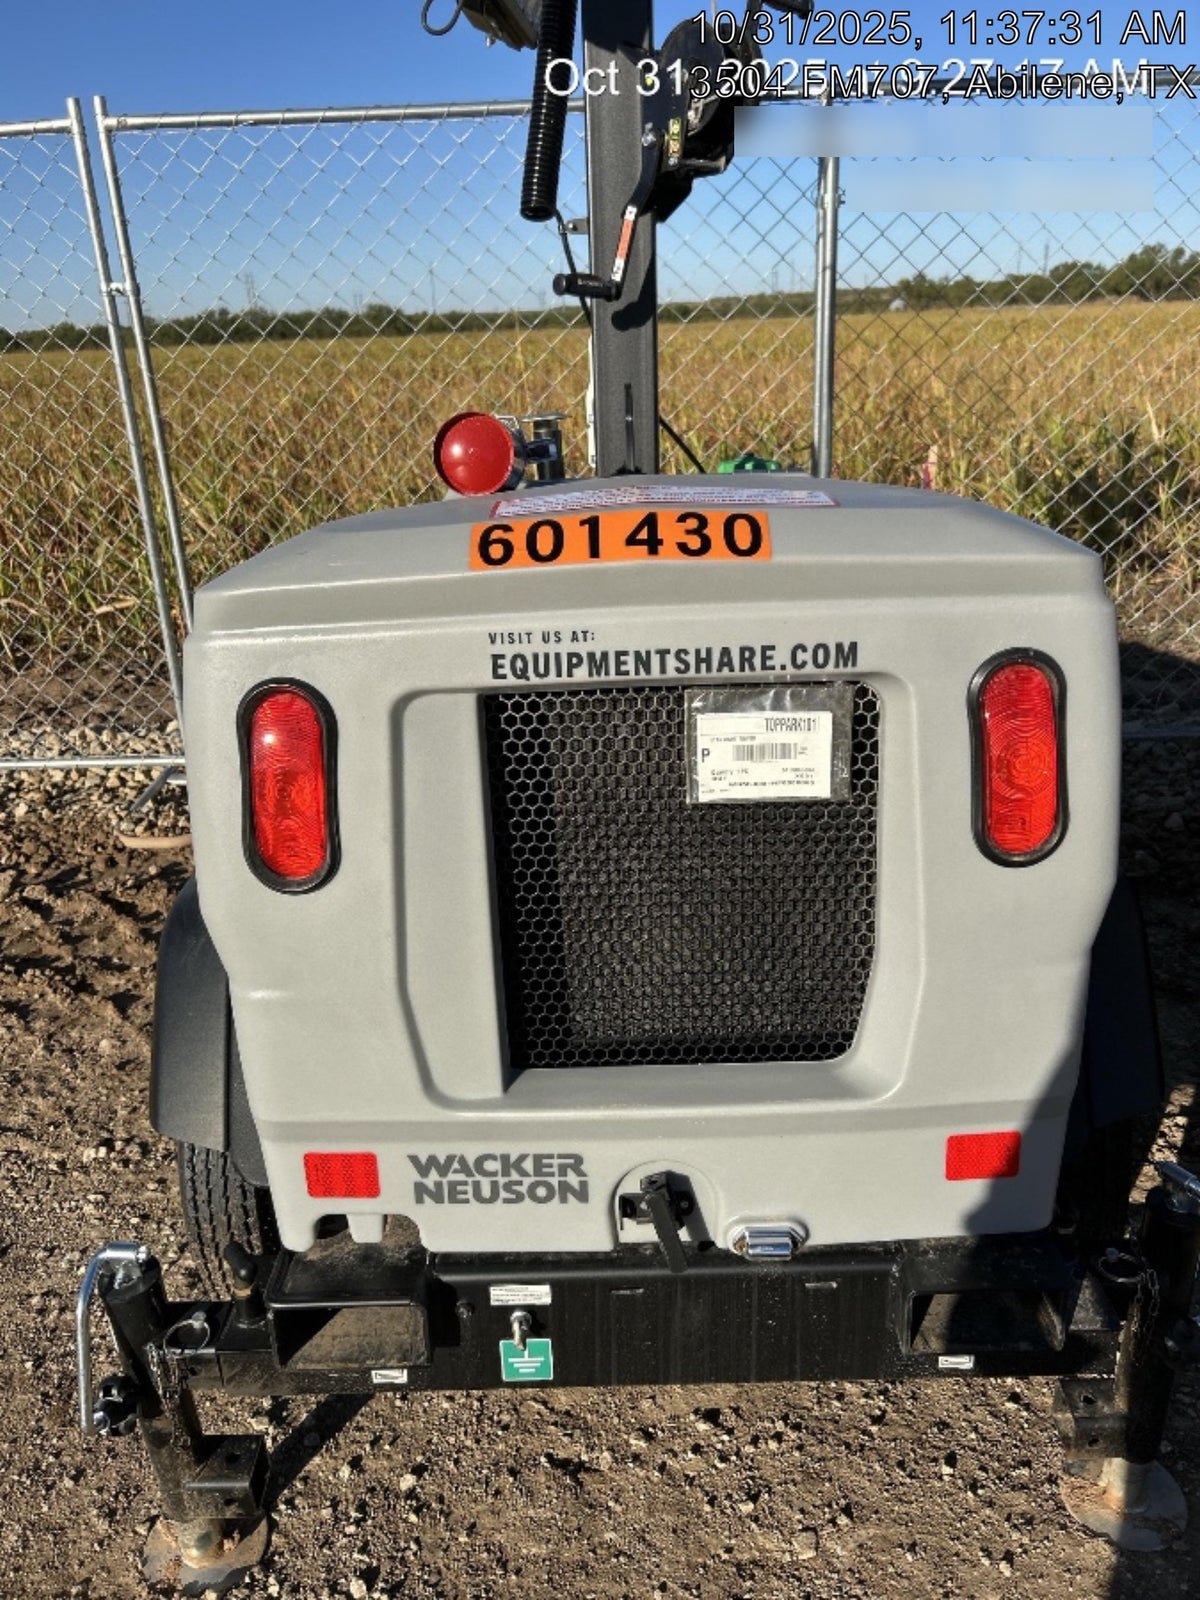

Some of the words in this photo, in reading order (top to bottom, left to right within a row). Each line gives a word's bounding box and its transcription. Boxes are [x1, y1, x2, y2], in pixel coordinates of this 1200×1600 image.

[488, 631, 533, 645] VISIT
[541, 631, 563, 644] US
[570, 630, 596, 643] AT:
[491, 642, 858, 680] EQUIPMENTSHARE.COM
[701, 748, 711, 763] P
[407, 1153, 588, 1177] WACKER
[414, 1180, 588, 1204] NEUSON
